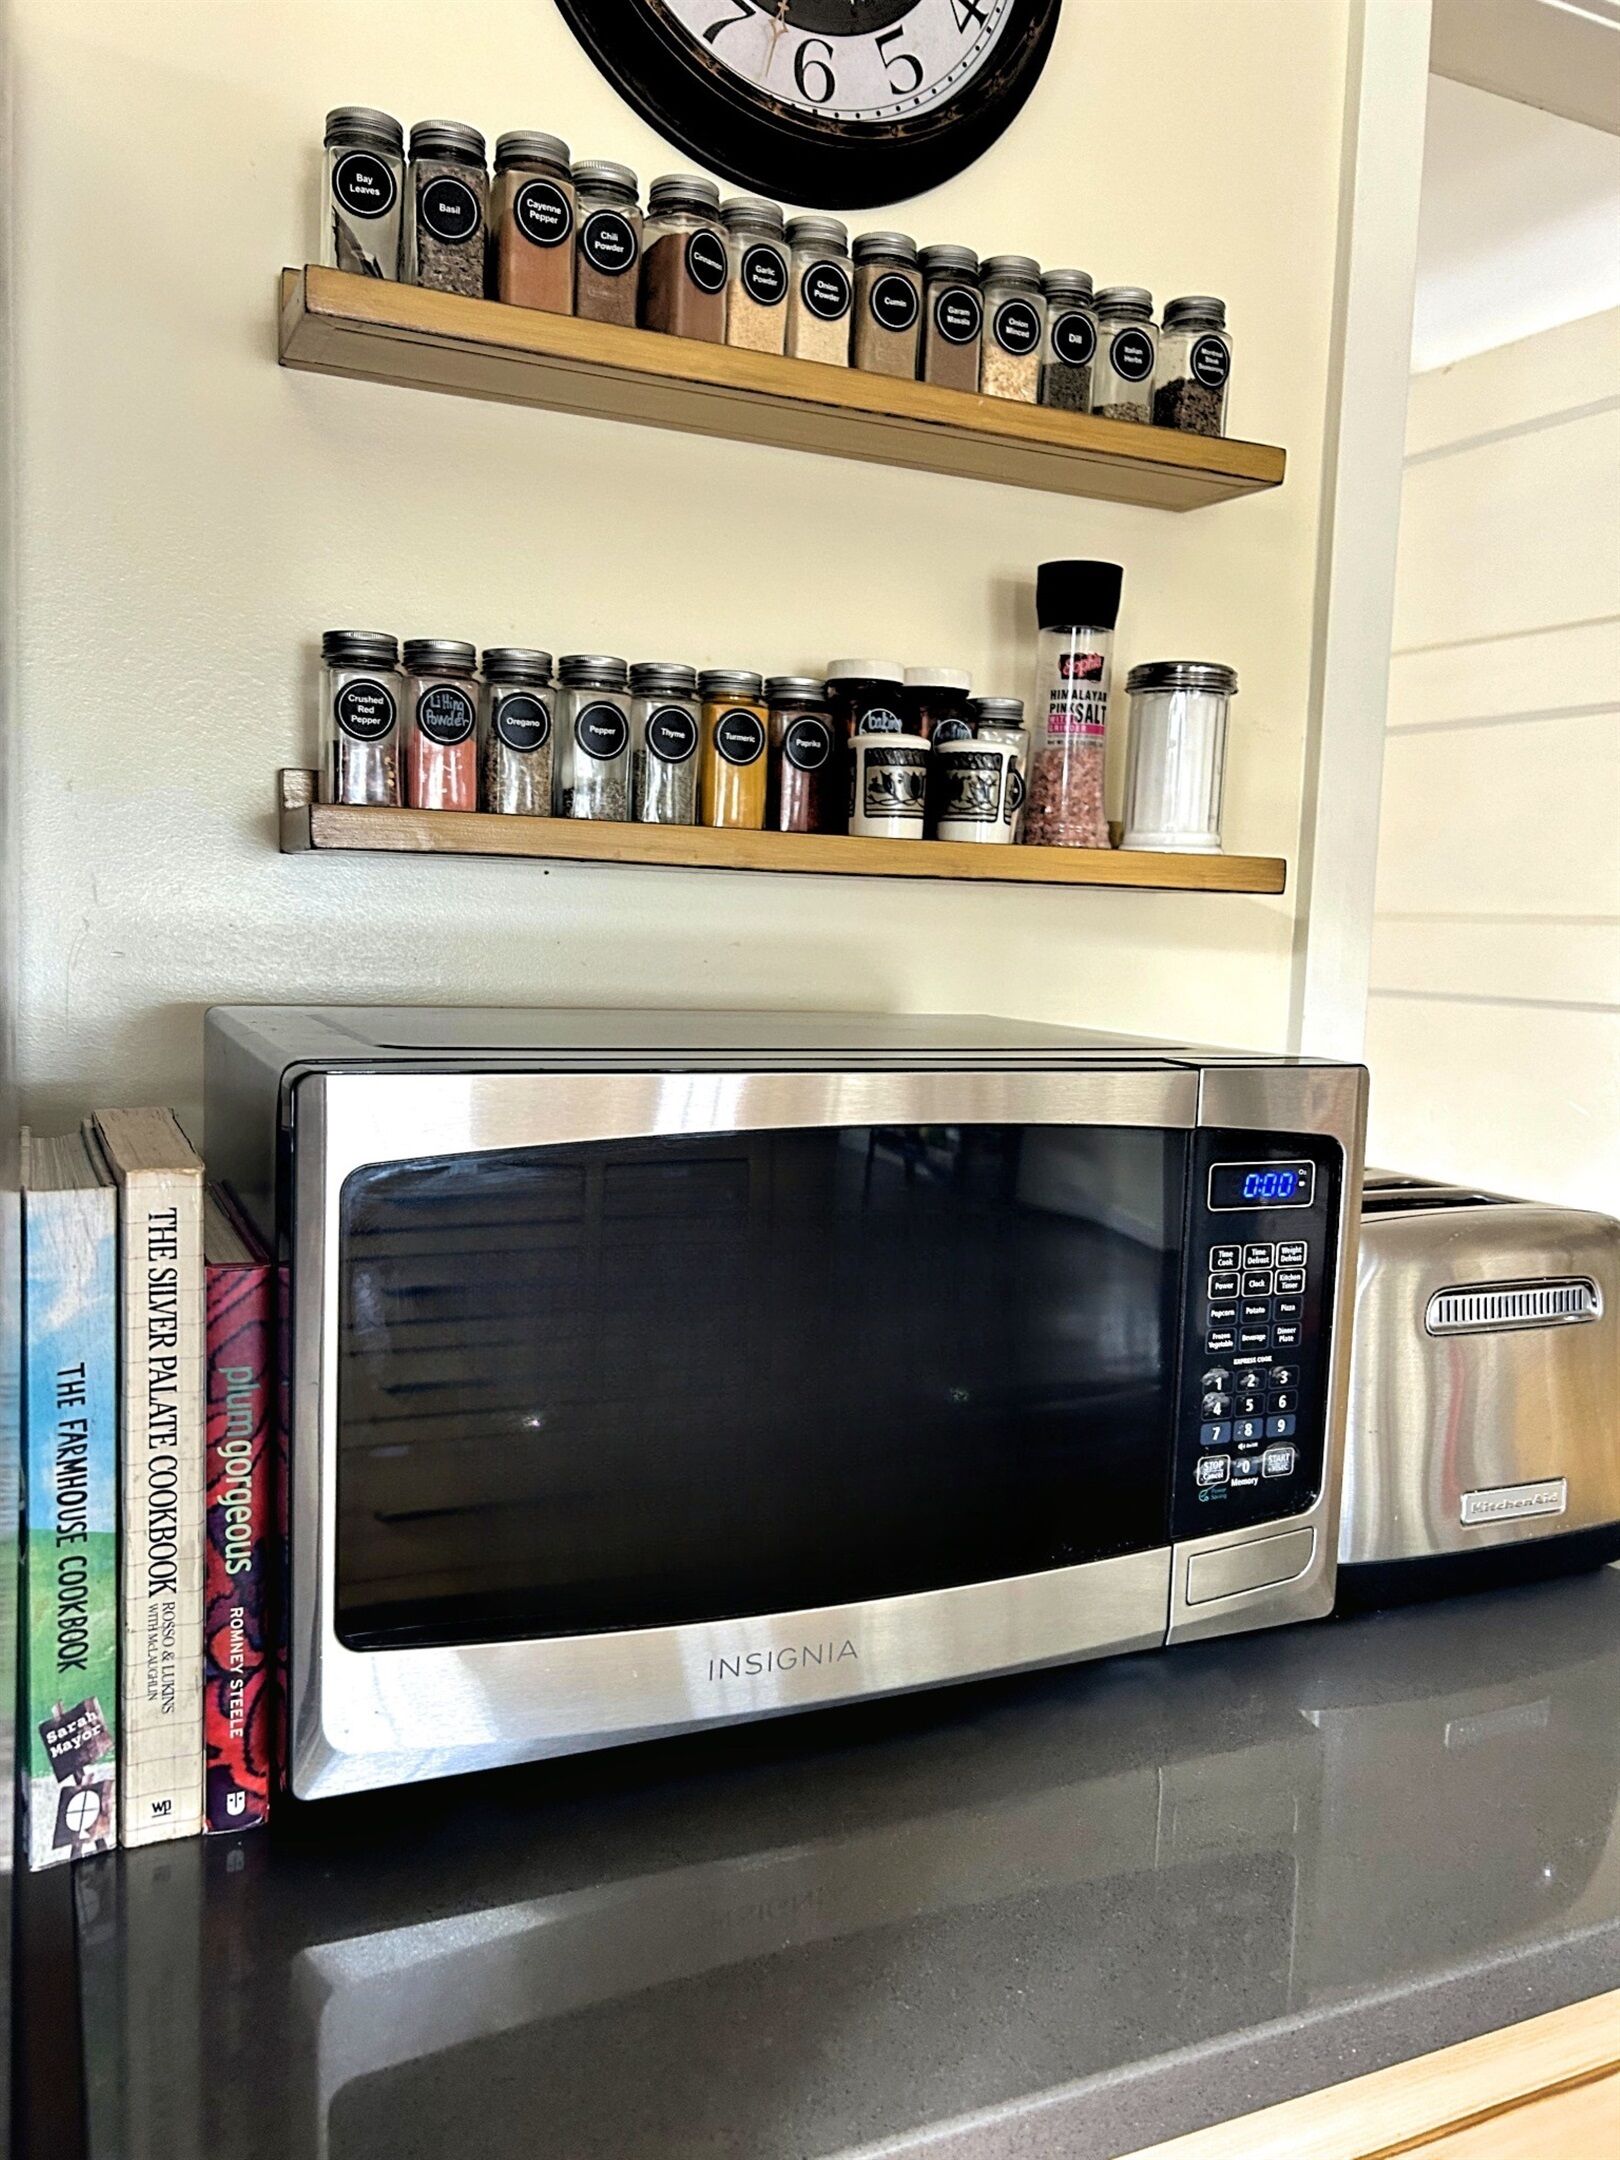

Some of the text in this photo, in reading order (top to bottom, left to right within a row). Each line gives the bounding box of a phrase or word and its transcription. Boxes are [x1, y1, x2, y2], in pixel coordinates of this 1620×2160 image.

[875, 24, 924, 95] 5
[794, 38, 836, 104] 6
[356, 173, 374, 186] Bay
[350, 184, 381, 197] Leaves
[439, 202, 461, 215] Basil
[526, 198, 562, 215] Cayenne
[529, 209, 559, 225] Pepper
[600, 231, 619, 242] Chili
[594, 241, 625, 254] Powder
[755, 264, 776, 277] Garlic
[752, 274, 778, 287] Powder
[817, 280, 839, 293] Onion
[814, 289, 841, 303] Powder
[947, 305, 971, 318] Garam
[1068, 332, 1083, 345] Dill
[348, 693, 384, 705] Crushed
[358, 704, 375, 714] Red
[1075, 703, 1107, 725] SALT
[351, 714, 381, 726] Pepper
[426, 708, 470, 727] Powder
[506, 716, 540, 728] Oregano
[589, 724, 616, 736] Pepper
[661, 727, 686, 740] Thyme
[725, 731, 756, 744] Turmeric
[796, 738, 822, 750] Paprika
[1243, 1173, 1293, 1198] 0:00
[1218, 1250, 1234, 1258] Time
[1251, 1248, 1267, 1256] Time
[1217, 1258, 1234, 1266] Cook
[1247, 1256, 1270, 1264] Defrost
[1215, 1282, 1234, 1290] Power
[1248, 1279, 1265, 1288] Clock
[1210, 1309, 1235, 1319] Popcorn
[1277, 1327, 1297, 1335] Dinner
[1279, 1334, 1294, 1343] Plate
[1215, 1376, 1222, 1391] 1
[1247, 1373, 1256, 1388] 2
[1279, 1371, 1289, 1384] 3
[148, 1207, 178, 1598] THE SILVER PALATE COOKBOOK
[1245, 1398, 1254, 1412] 5
[1278, 1394, 1287, 1409] 6
[1212, 1402, 1222, 1416] 4
[1244, 1422, 1253, 1437] 8
[1277, 1418, 1286, 1433] 9
[1212, 1426, 1221, 1441] 7
[1203, 1460, 1224, 1470] STOP
[1242, 1460, 1250, 1474] 0
[1230, 1477, 1259, 1487] Memory
[1471, 1491, 1559, 1514] KitchenAid
[56, 1362, 90, 1674] THE FARMHOUSE COOKBOOK
[148, 1603, 159, 1633] WITH
[161, 1602, 176, 1715] ROSSO & LUKINS
[708, 1639, 858, 1681] INSIGNIA
[230, 1607, 244, 1739] ROMNEY STEELE
[46, 1710, 98, 1744] Sarah
[50, 1724, 102, 1759] Mayor
